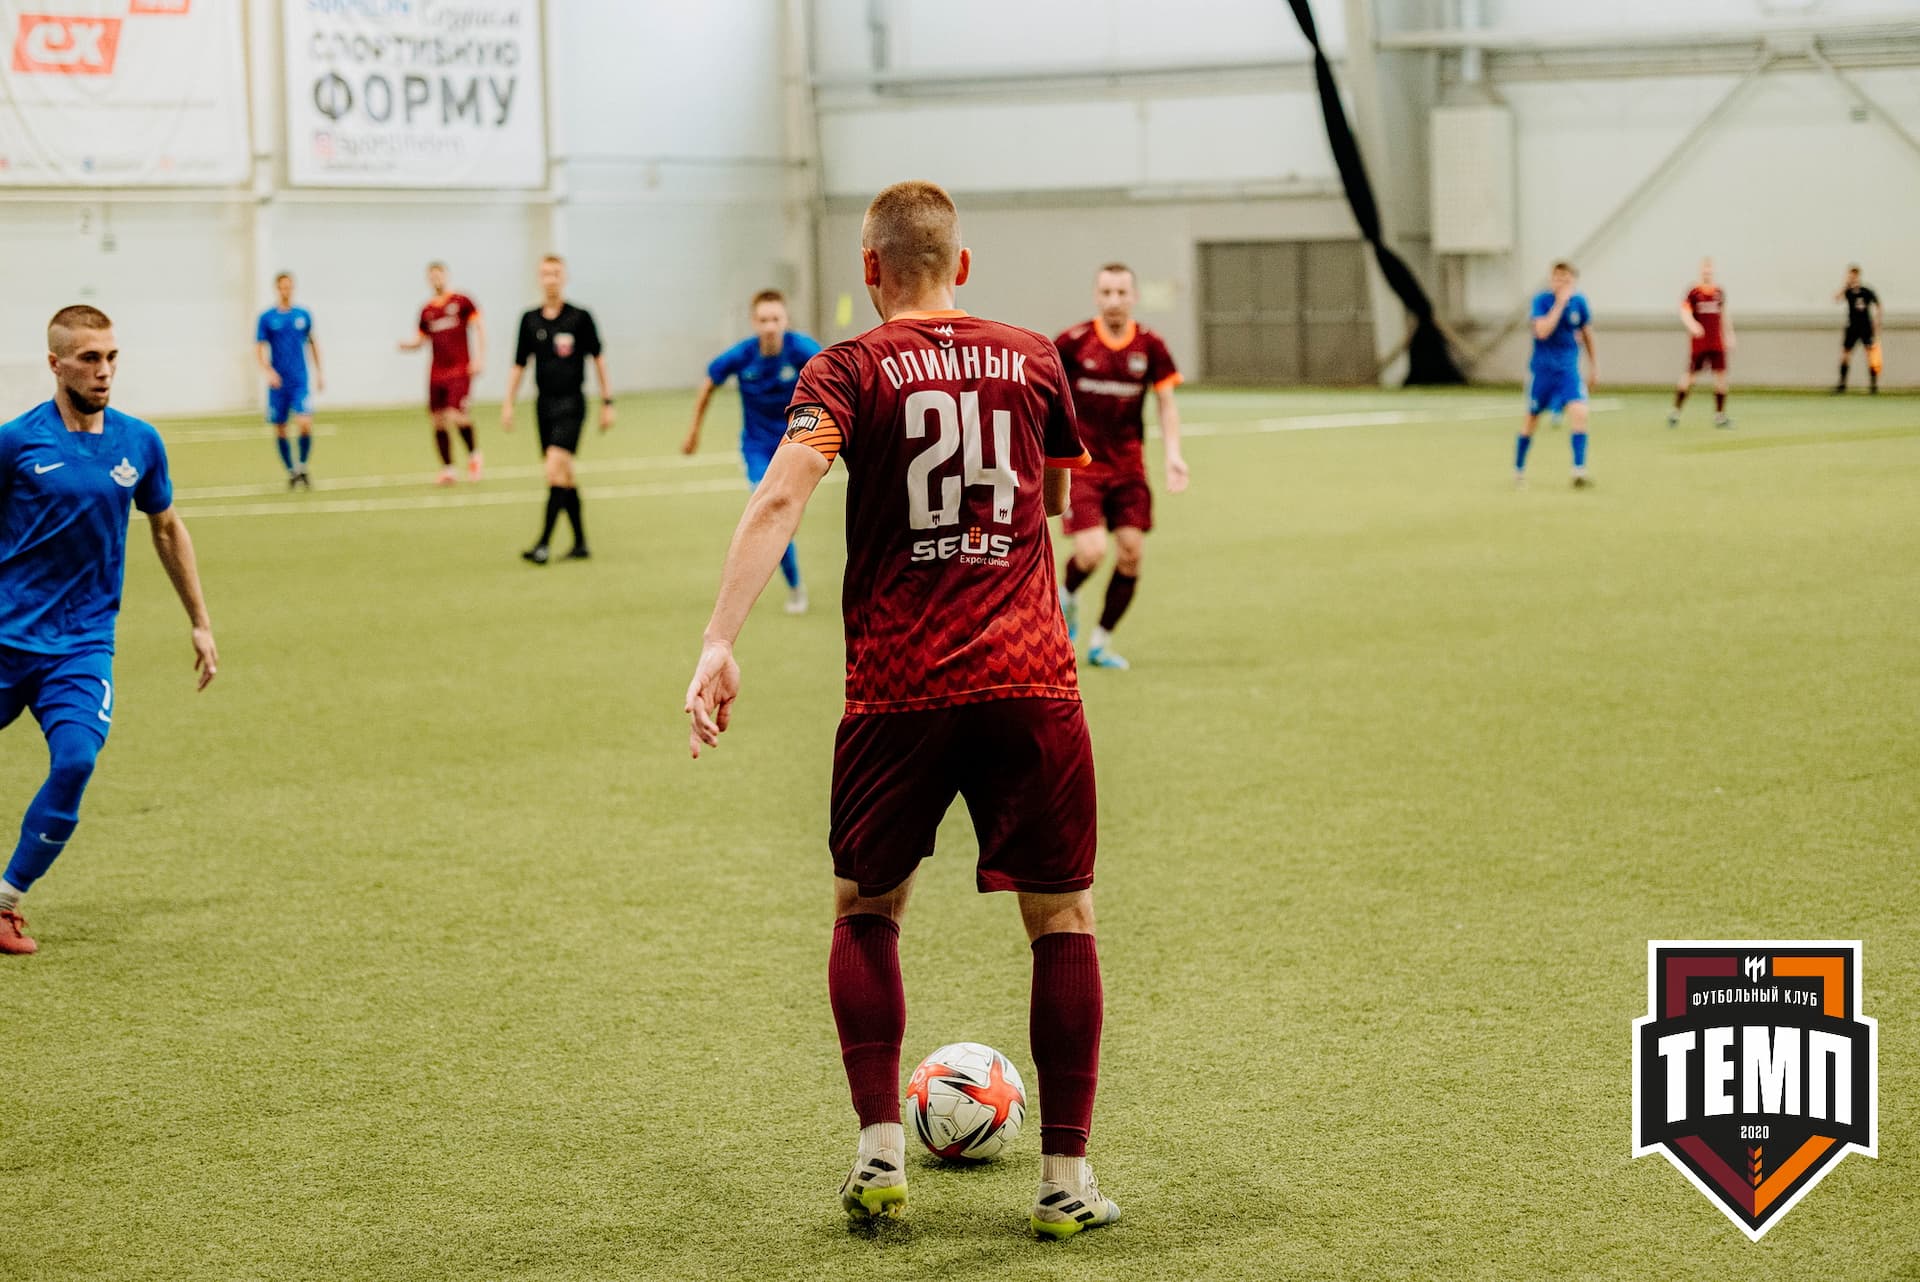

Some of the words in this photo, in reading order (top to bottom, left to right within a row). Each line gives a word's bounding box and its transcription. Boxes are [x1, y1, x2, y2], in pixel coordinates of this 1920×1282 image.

[313, 73, 516, 125] ФОРМУ
[881, 340, 1027, 389] ОЛИЙНЫК
[905, 391, 1019, 530] 24
[960, 554, 987, 565] Export
[988, 557, 1010, 568] Union
